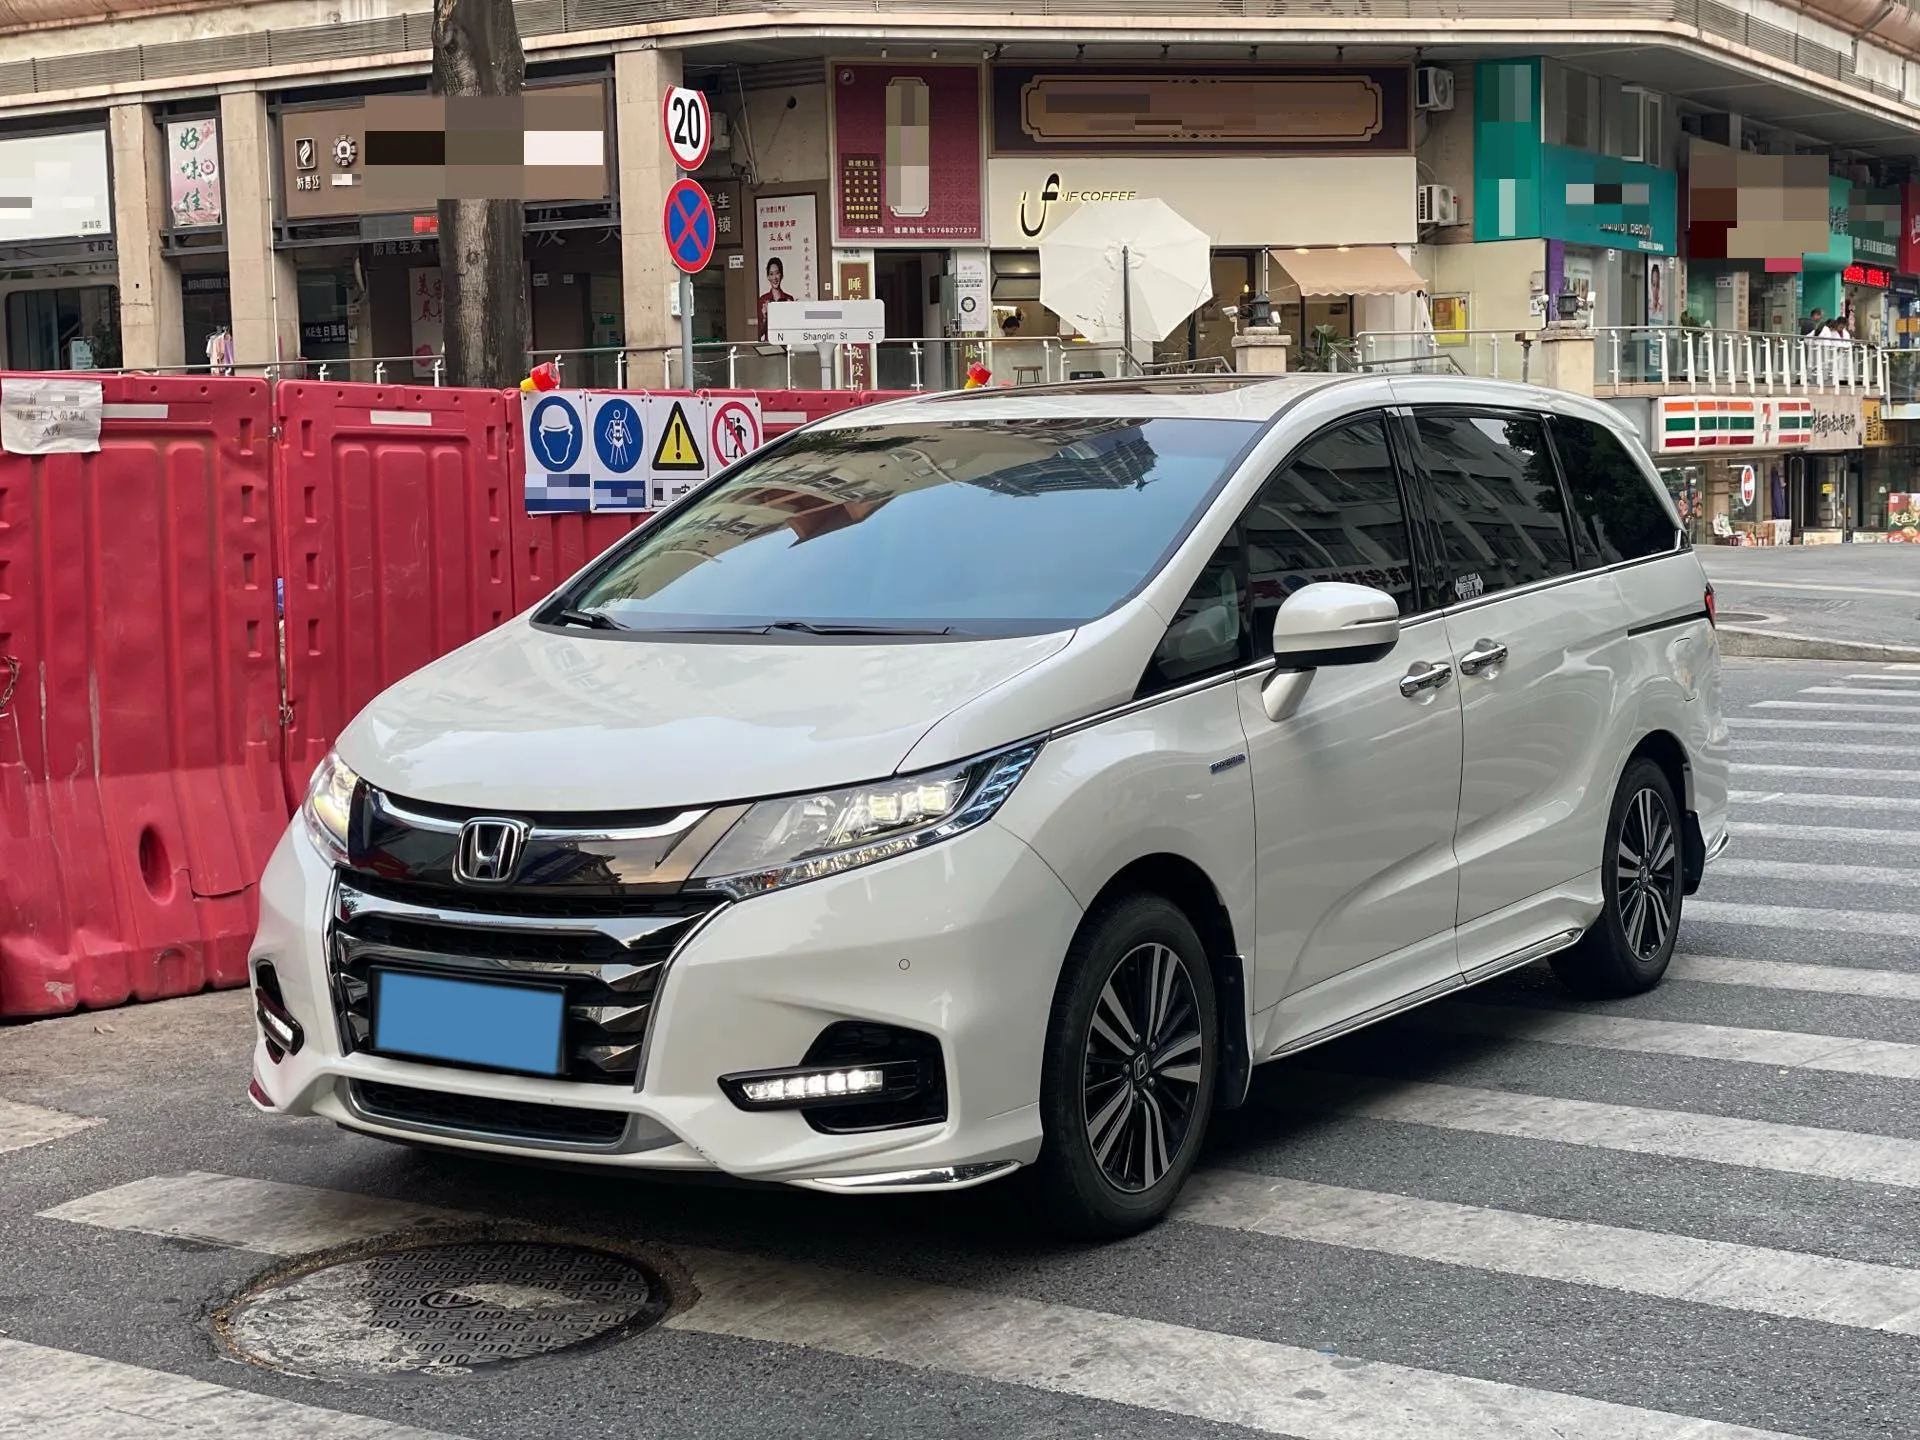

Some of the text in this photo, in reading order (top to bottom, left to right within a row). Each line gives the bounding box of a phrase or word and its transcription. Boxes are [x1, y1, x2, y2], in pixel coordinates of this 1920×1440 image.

[673, 96, 702, 149] 20
[180, 127, 205, 211] 好味佳
[1080, 191, 1136, 201] COFFEE
[777, 331, 874, 342] N Shanglin St S
